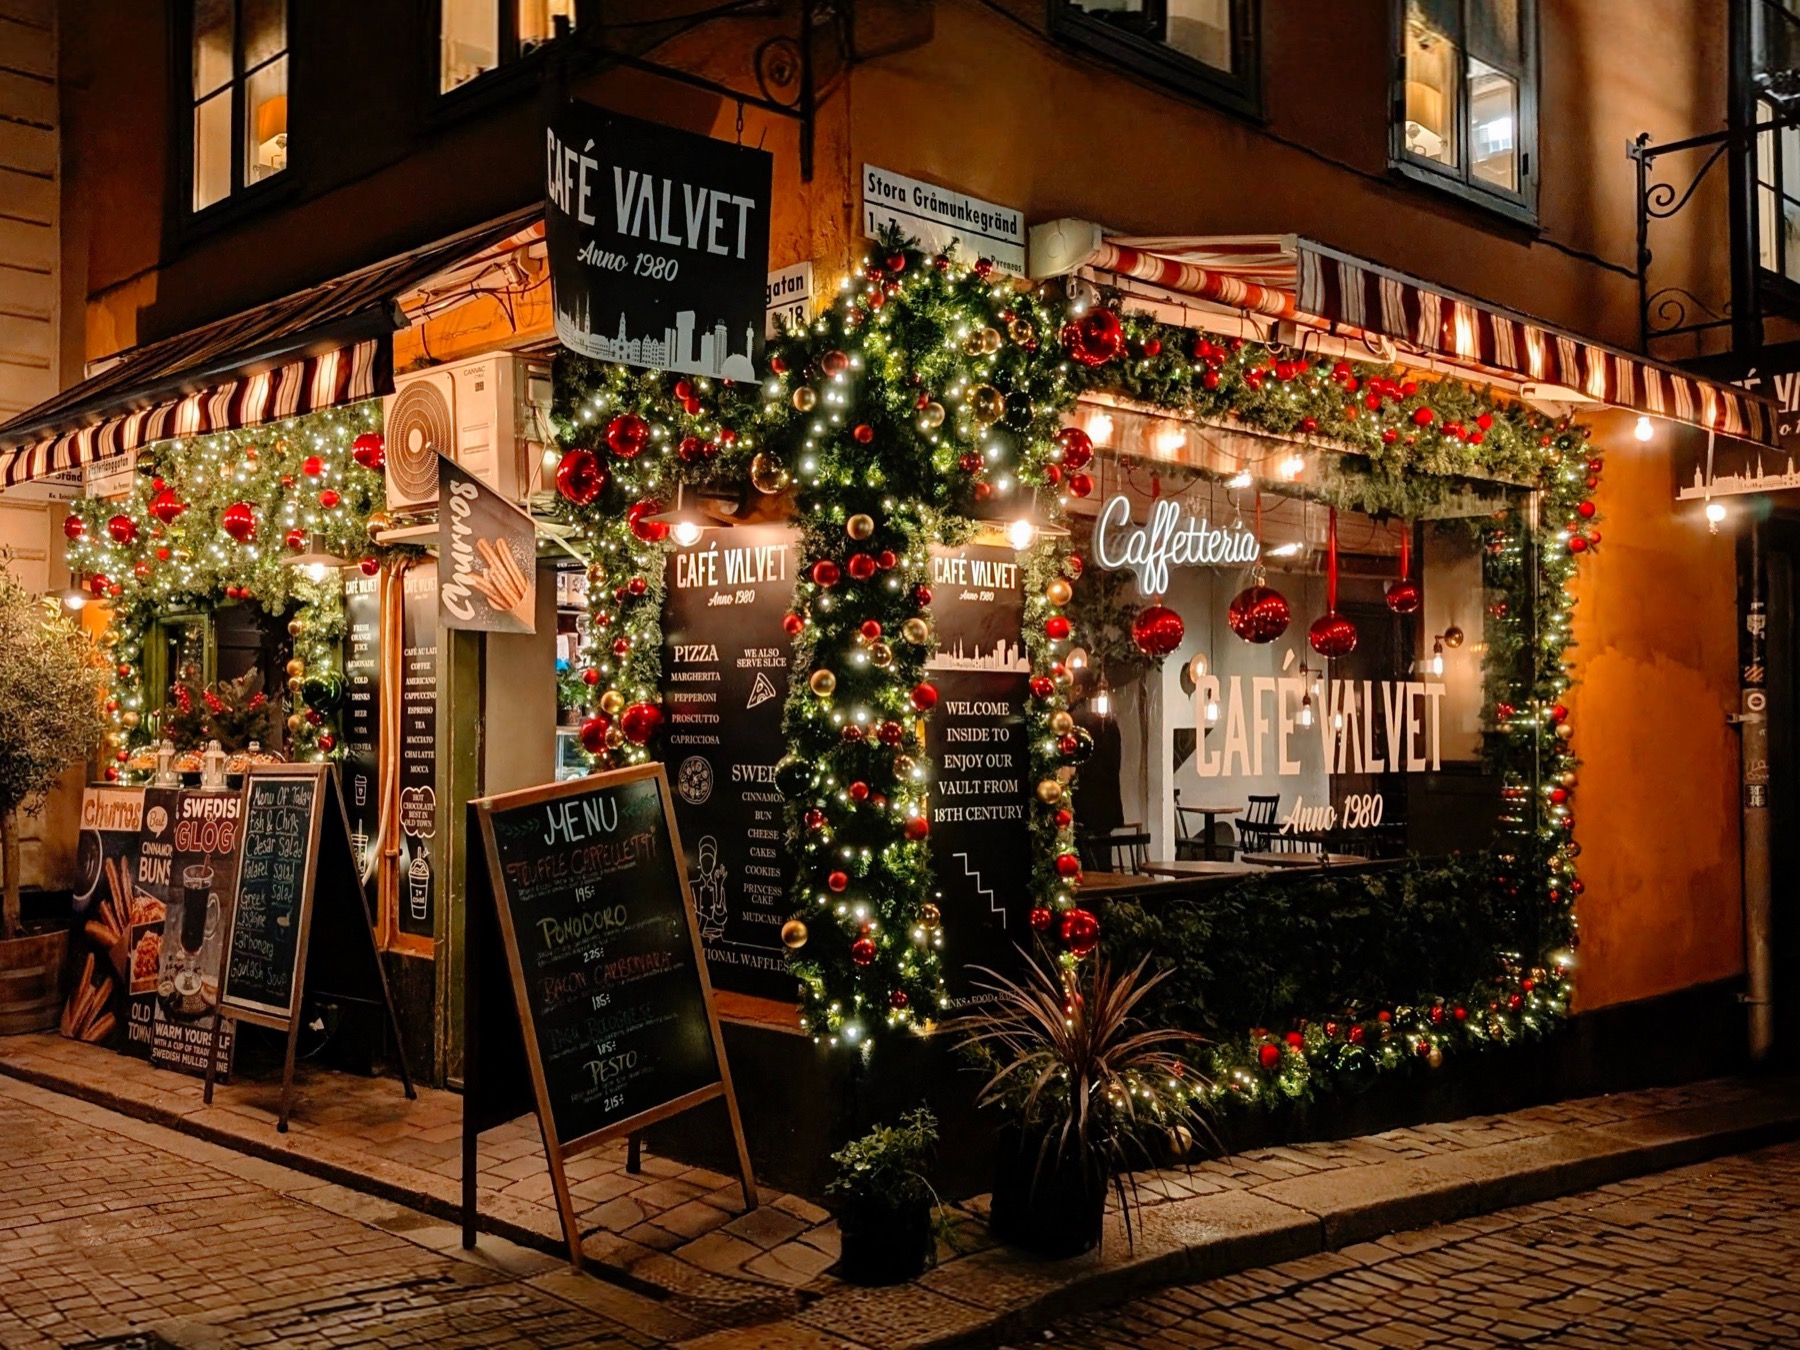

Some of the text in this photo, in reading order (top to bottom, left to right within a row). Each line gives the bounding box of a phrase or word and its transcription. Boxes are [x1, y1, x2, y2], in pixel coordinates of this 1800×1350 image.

[547, 126, 756, 260] CAFÉ VALVET
[869, 172, 1017, 235] Stora Gråmunkegränd
[577, 240, 679, 282] Anno 1980
[441, 480, 478, 621] Churros
[1099, 496, 1261, 595] Caffetteria
[676, 541, 789, 589] CAFÉ VALVET
[934, 553, 1018, 589] CAFÉ VALVET
[708, 590, 755, 607] Anno 1980
[979, 590, 994, 602] 1980
[673, 644, 720, 663] PIZZA
[744, 648, 780, 658] WE ALSO
[737, 657, 787, 668] SERVE SLICE
[406, 677, 436, 685] AMERICANO
[671, 671, 721, 682] MARGHERITA
[352, 693, 370, 701] DRINKS
[674, 693, 717, 703] PEPPERONI
[354, 710, 367, 718] BEER
[408, 706, 433, 714] ESPRESSO
[946, 701, 1010, 716] WELCOME
[1195, 648, 1446, 778] CAFÉ VALVET
[415, 721, 426, 729] TEA
[671, 714, 720, 724] PROSCIUTTO
[670, 734, 720, 745] CAPRICCIOSA
[946, 727, 1010, 742] INSIDE TO
[944, 752, 1013, 772] ENJOY OUR
[938, 779, 1018, 795] VAULT FROM
[253, 786, 274, 806] Menu
[84, 791, 141, 830] Churros
[403, 802, 434, 811] CHOCOLATE
[934, 805, 1024, 823] 18TH CENTURY
[250, 810, 264, 831] Fish
[267, 810, 273, 831] &
[544, 797, 618, 845] MENU
[755, 810, 772, 820] BUN
[1279, 794, 1383, 836] Anno 1980
[175, 812, 238, 854] GLÖG
[747, 828, 780, 840] CHEESE
[245, 834, 304, 858] Caesar Salad
[749, 847, 776, 858] CAKES
[745, 864, 781, 877] COOKIES
[743, 883, 782, 896] PRINCESS
[751, 894, 774, 906] CAKE
[742, 911, 783, 925] MUDCAKE
[740, 953, 790, 973] WAFFLES
[971, 993, 994, 1003] FOOD
[131, 1002, 151, 1023] OLD
[128, 1021, 152, 1044] TOWN
[155, 1023, 182, 1040] WARM
[154, 1038, 166, 1047] WITH
[167, 1040, 172, 1048] A
[173, 1041, 184, 1050] CUP
[185, 1044, 192, 1052] OF
[152, 1047, 180, 1063] SWEDISH
[182, 1054, 208, 1068] MULLED
[583, 1050, 638, 1088] PESTO
